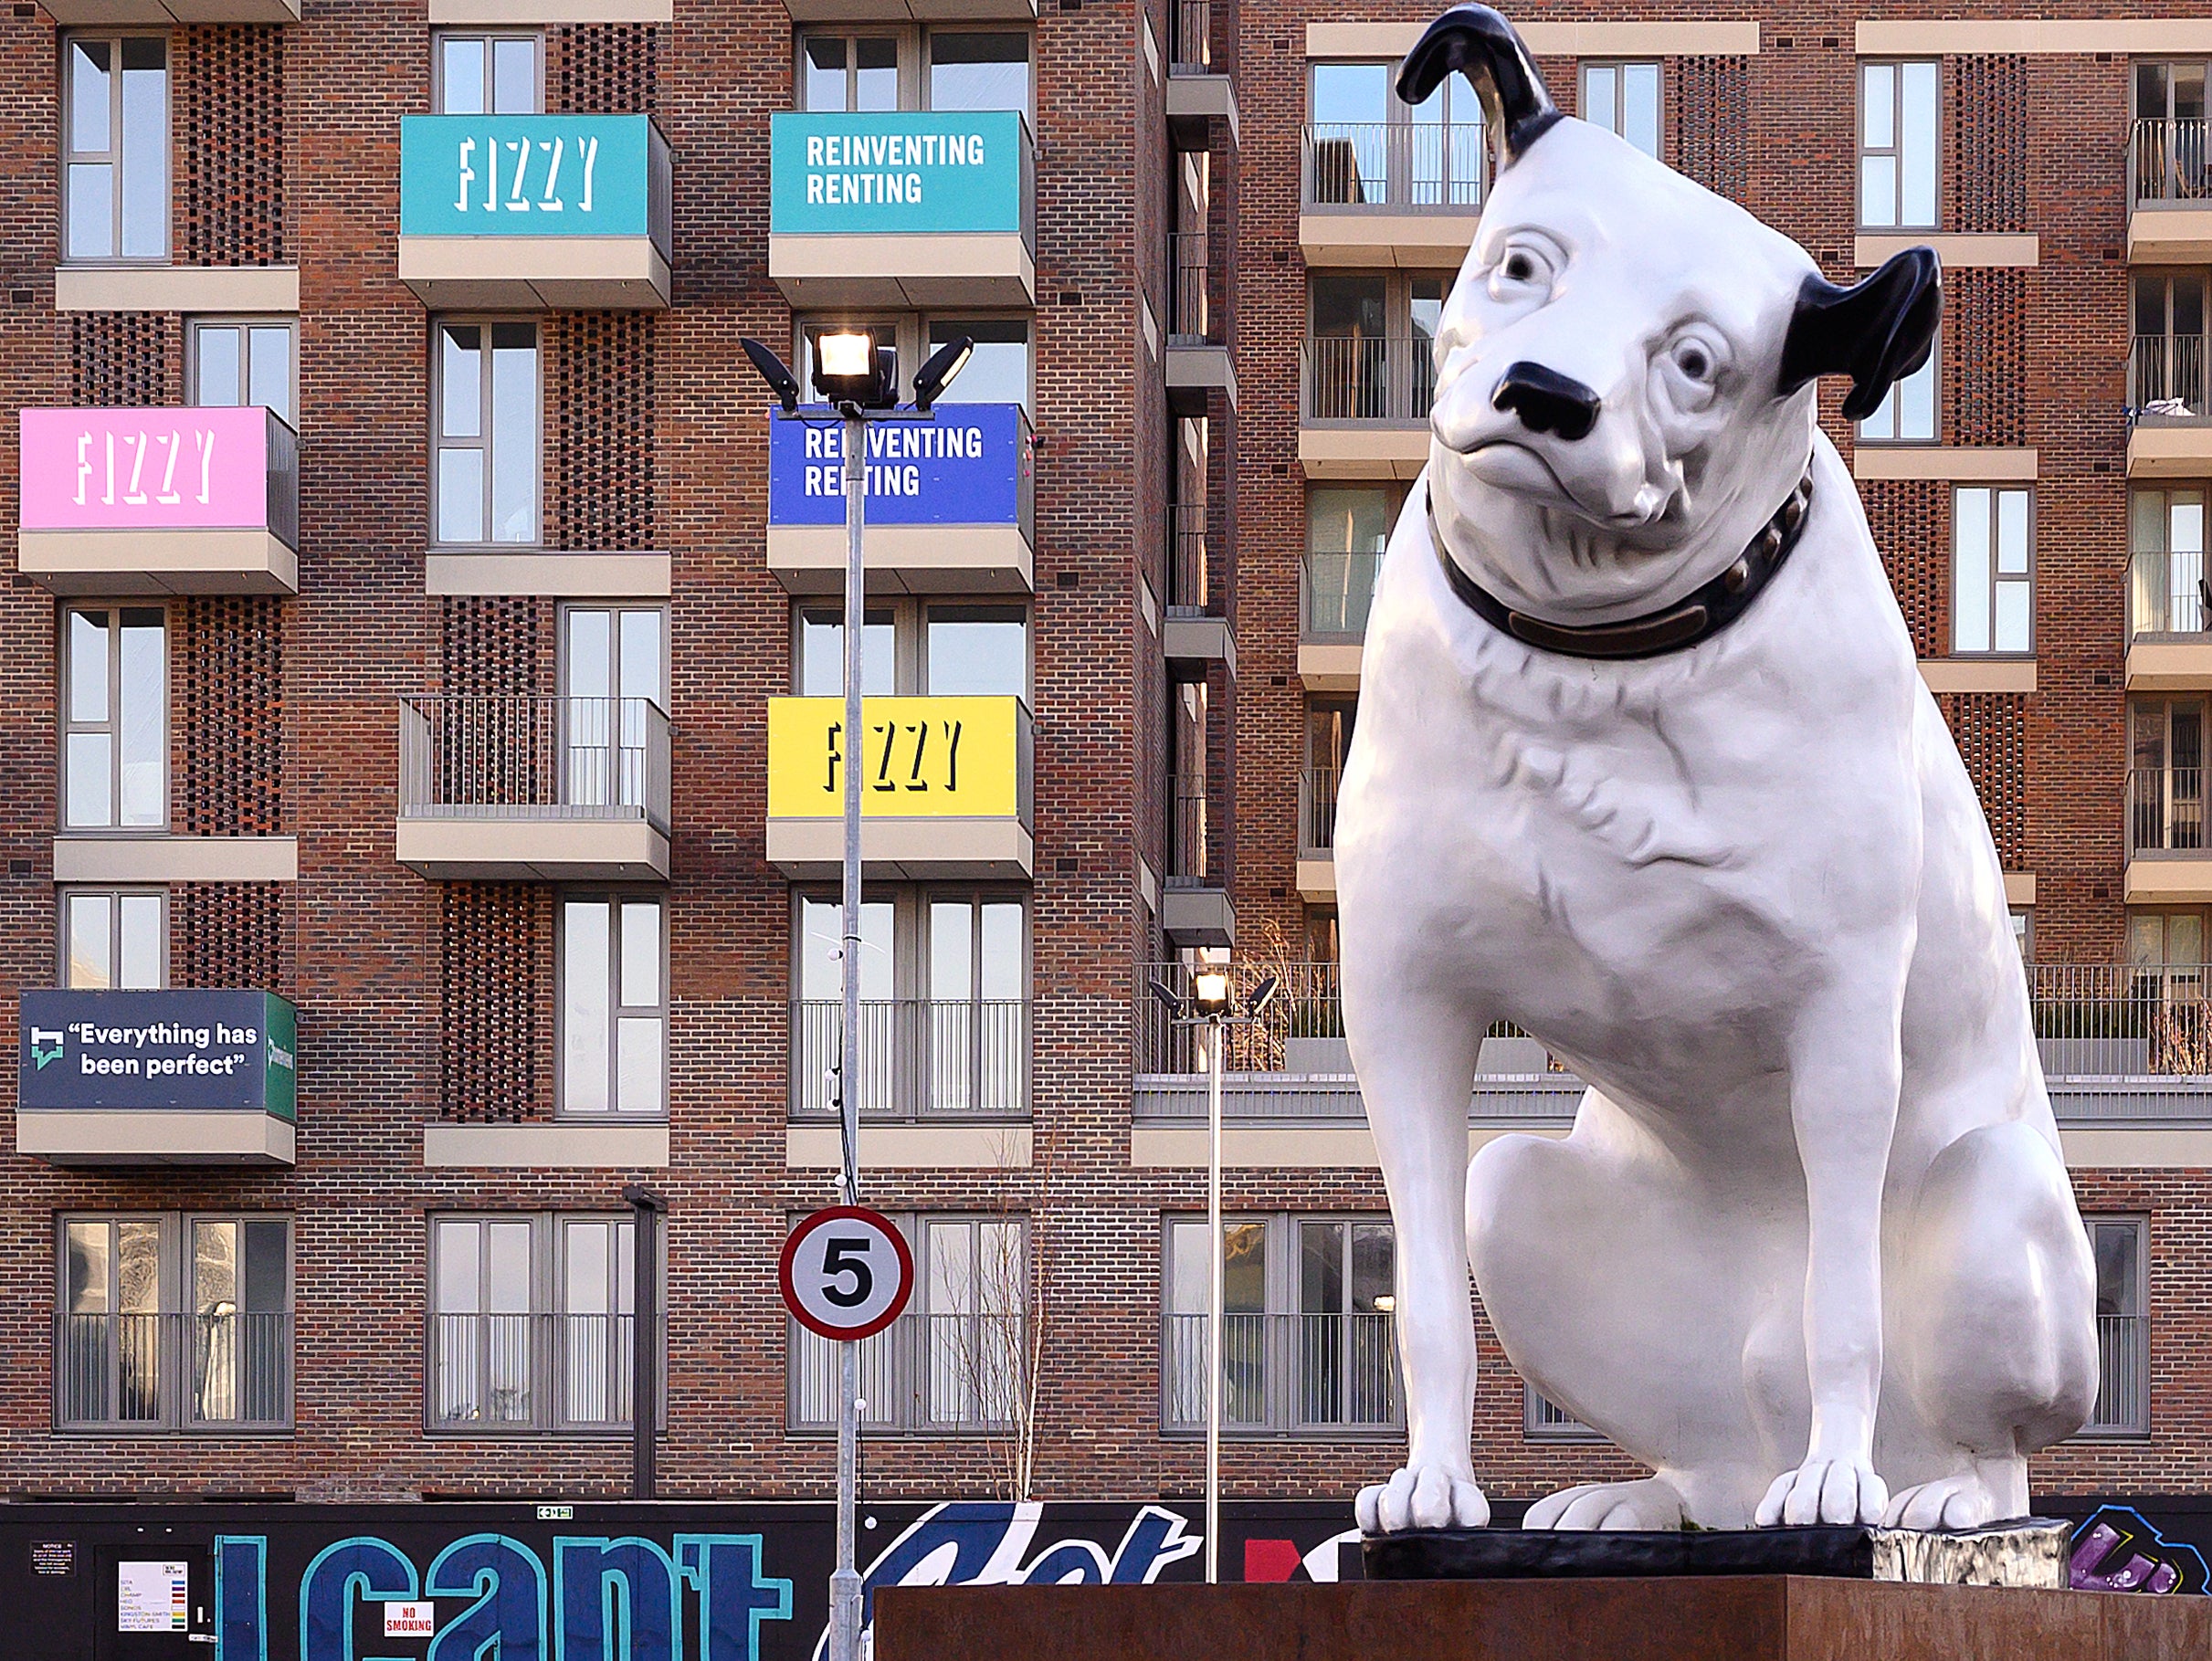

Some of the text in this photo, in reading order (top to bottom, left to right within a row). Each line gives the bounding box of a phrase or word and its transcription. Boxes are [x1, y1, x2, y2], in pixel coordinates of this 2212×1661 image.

[806, 134, 984, 166] REINVENTING
[454, 136, 598, 212] FIZZY
[806, 173, 922, 204] RENTING
[805, 427, 982, 458] REIVENTING
[72, 429, 216, 505] FIZZY
[823, 720, 962, 793] FZZY
[68, 1022, 258, 1048] “Everything has
[80, 1054, 139, 1075] been
[145, 1054, 245, 1079] perfect”
[821, 1238, 873, 1307] 5
[386, 1620, 431, 1631] SMOKING
[402, 1607, 416, 1618] NO
